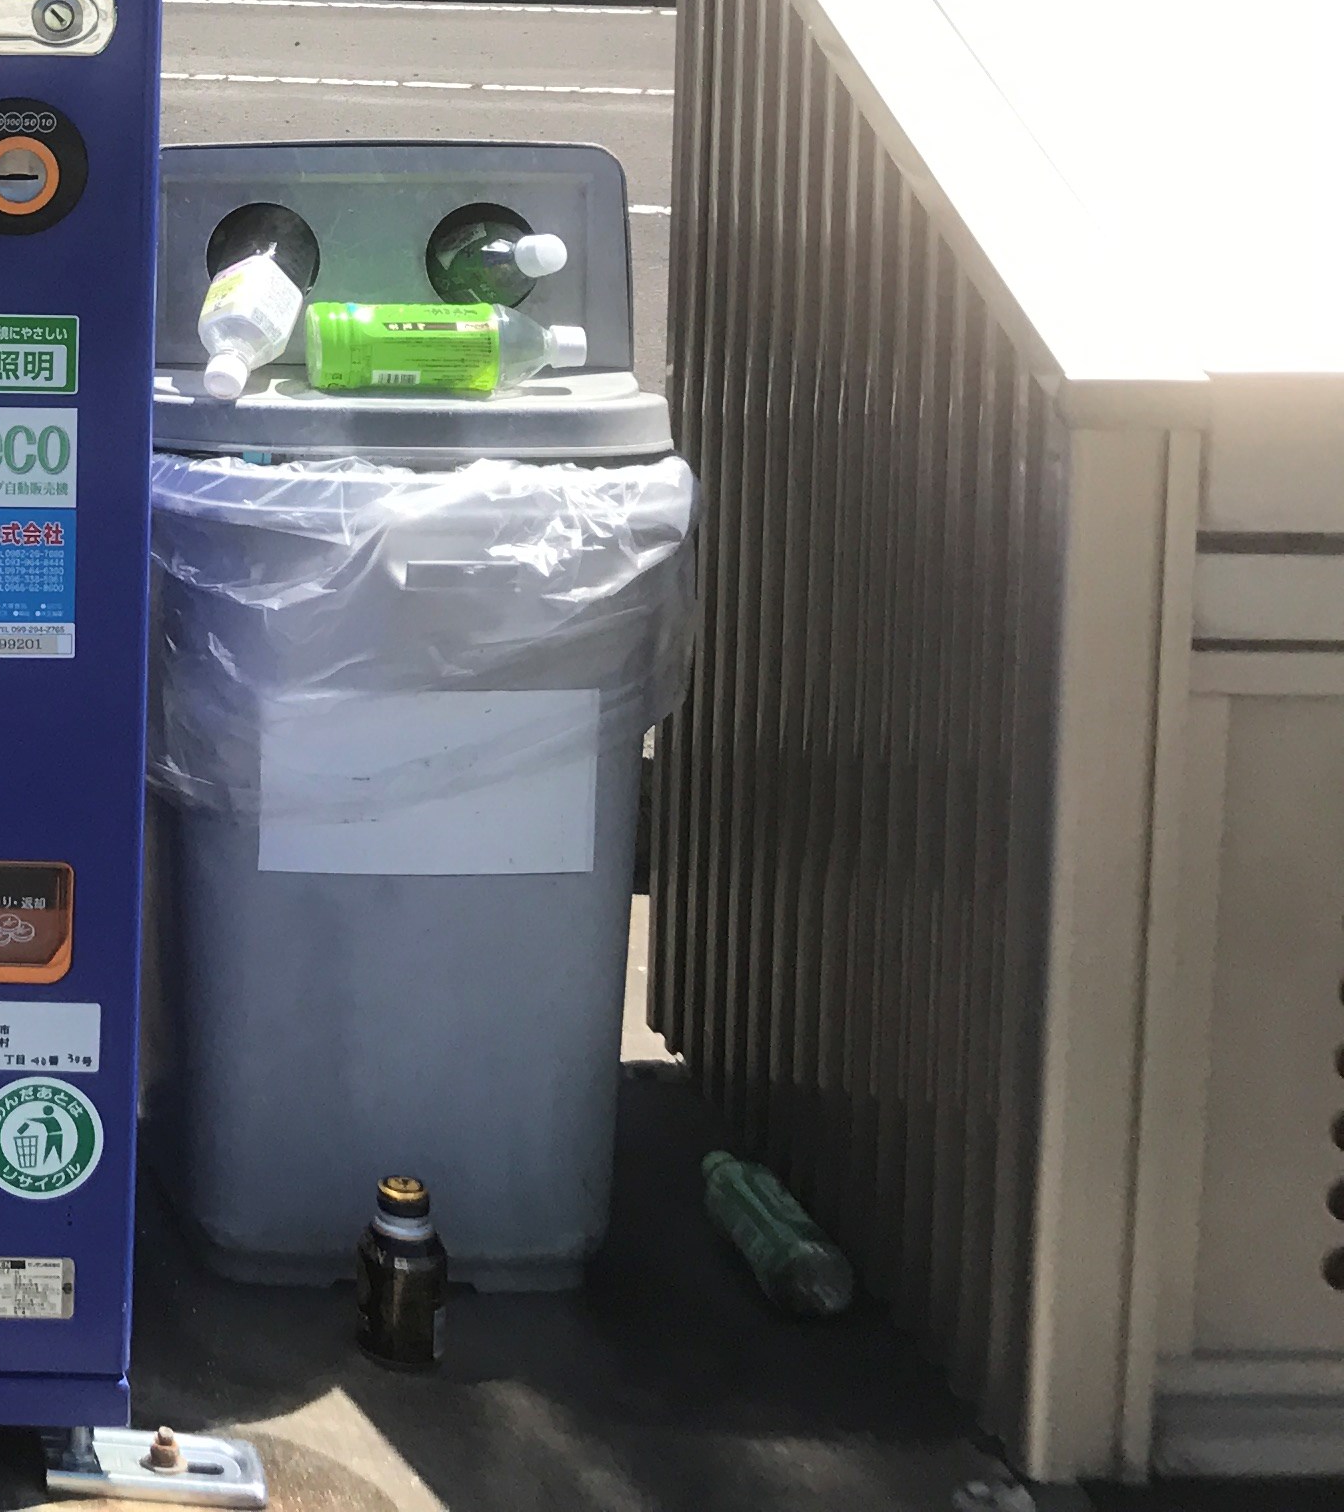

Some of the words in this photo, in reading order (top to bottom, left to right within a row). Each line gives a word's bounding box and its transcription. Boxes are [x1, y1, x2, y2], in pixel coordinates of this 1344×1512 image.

[24, 117, 37, 126] 50
[41, 117, 52, 126] 10
[2, 1161, 82, 1191] リサイクル
